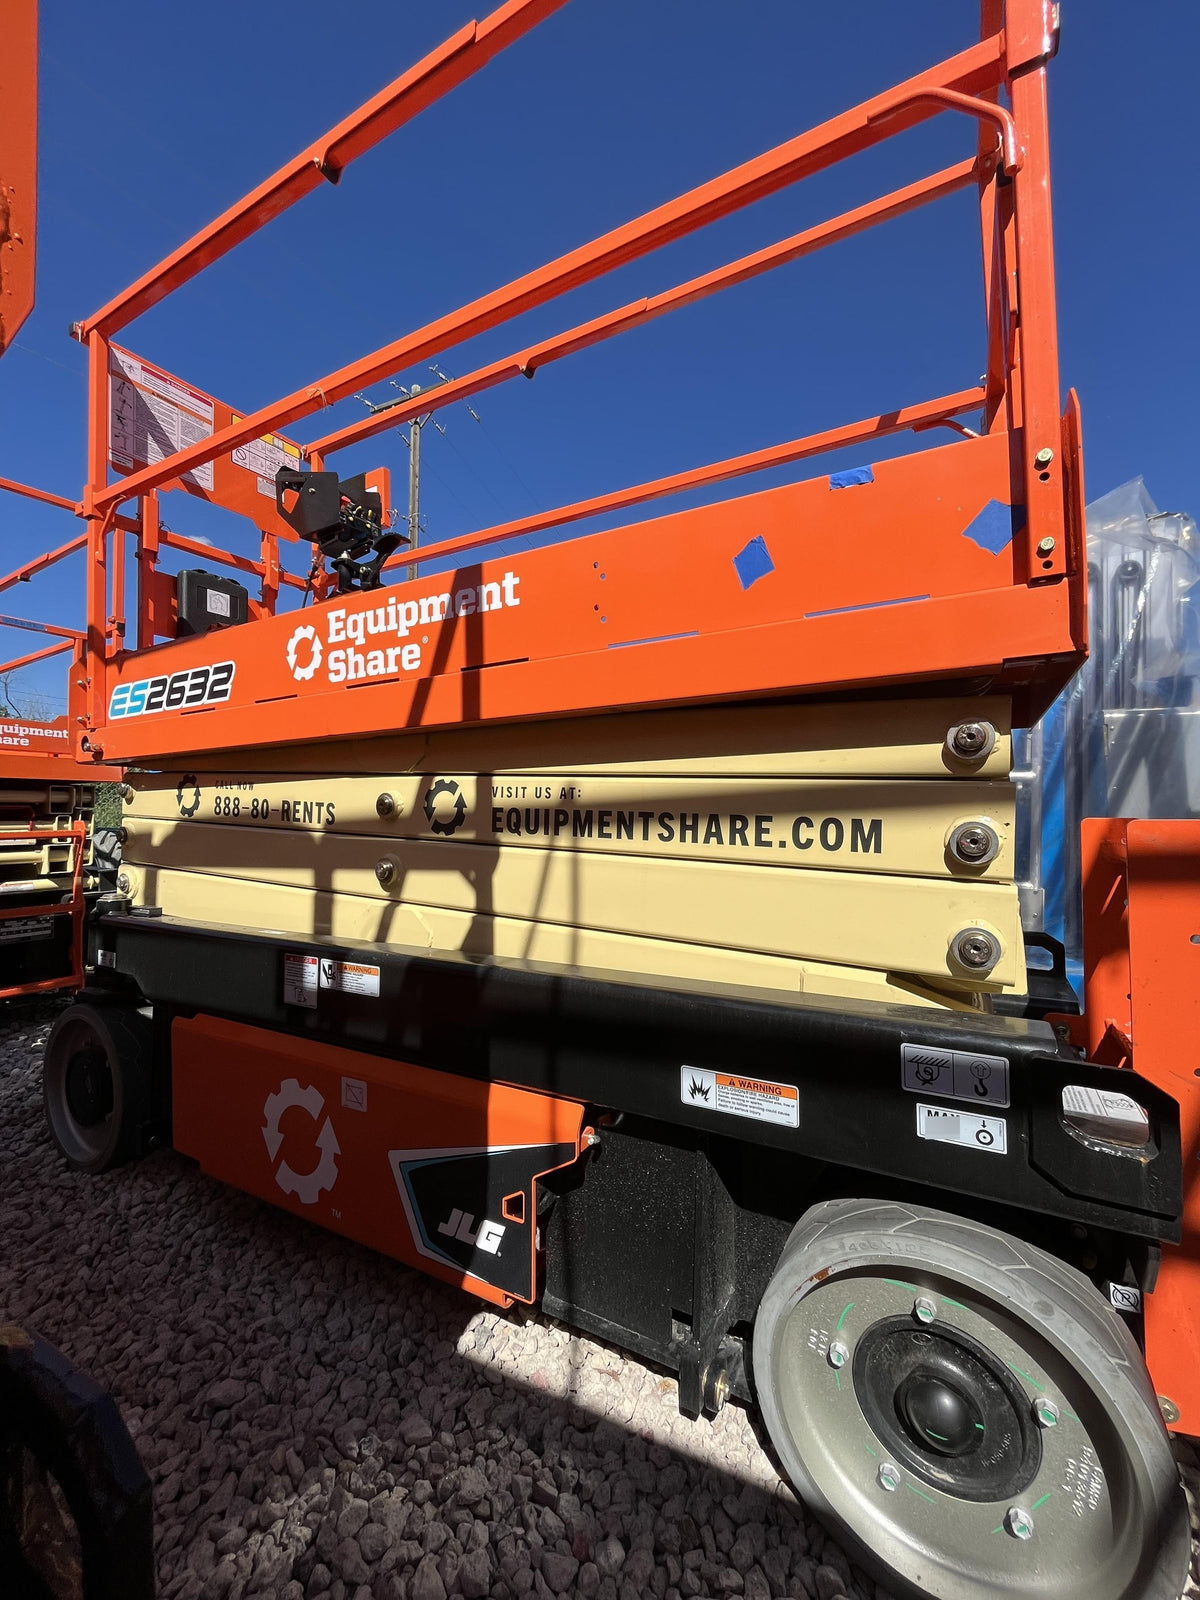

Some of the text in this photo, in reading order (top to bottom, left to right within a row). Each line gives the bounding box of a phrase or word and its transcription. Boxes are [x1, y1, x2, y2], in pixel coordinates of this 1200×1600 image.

[327, 571, 520, 645] Equipment
[327, 643, 421, 683] Share
[109, 661, 235, 719] ES2632
[0, 737, 29, 746] are
[215, 780, 254, 790] CALL NOW
[492, 786, 582, 800] VISIT US AT:
[214, 796, 336, 825] 888-80-RENTS
[491, 807, 883, 854] EQUIPMENTSHARE.COM
[738, 1080, 782, 1096] WARNING
[438, 1208, 506, 1255] JLG
